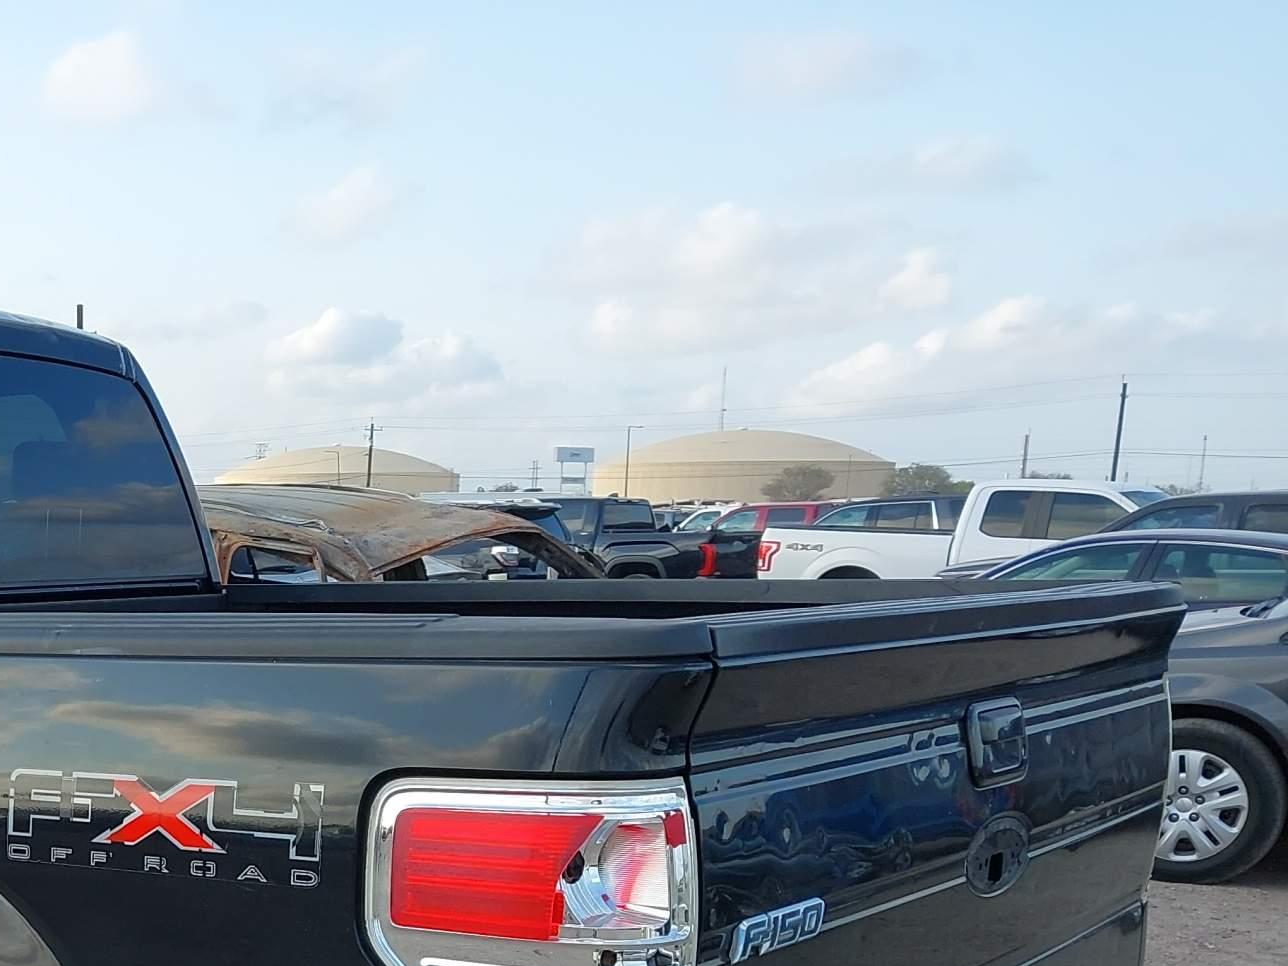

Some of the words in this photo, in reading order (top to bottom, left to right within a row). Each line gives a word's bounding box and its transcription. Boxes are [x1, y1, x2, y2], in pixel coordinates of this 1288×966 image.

[8, 769, 324, 861] FX4
[8, 843, 113, 866] OFF
[144, 855, 319, 887] ROAD
